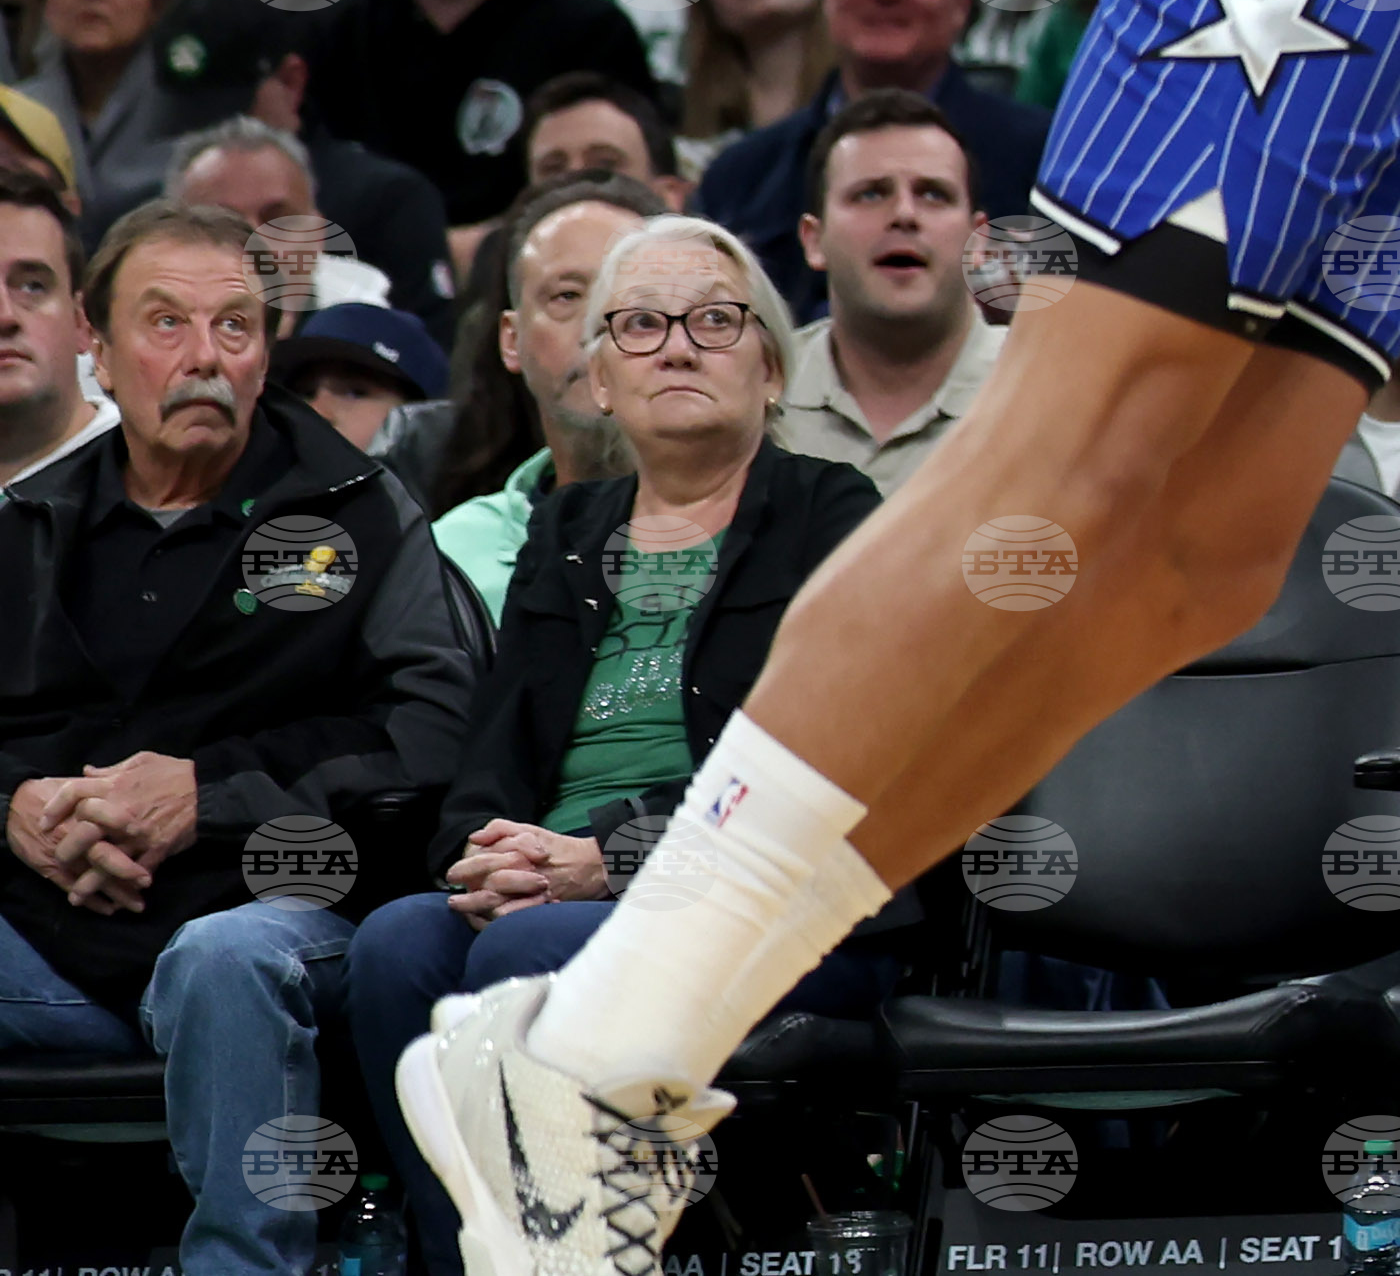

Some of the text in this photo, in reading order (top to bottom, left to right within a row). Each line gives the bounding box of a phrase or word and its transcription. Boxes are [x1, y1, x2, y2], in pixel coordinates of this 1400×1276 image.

[740, 1252, 816, 1276] SEAT
[948, 1245, 1006, 1270] FLR
[1076, 1240, 1153, 1267] ROW
[1159, 1239, 1204, 1266] AA
[1240, 1236, 1320, 1263] SEAT
